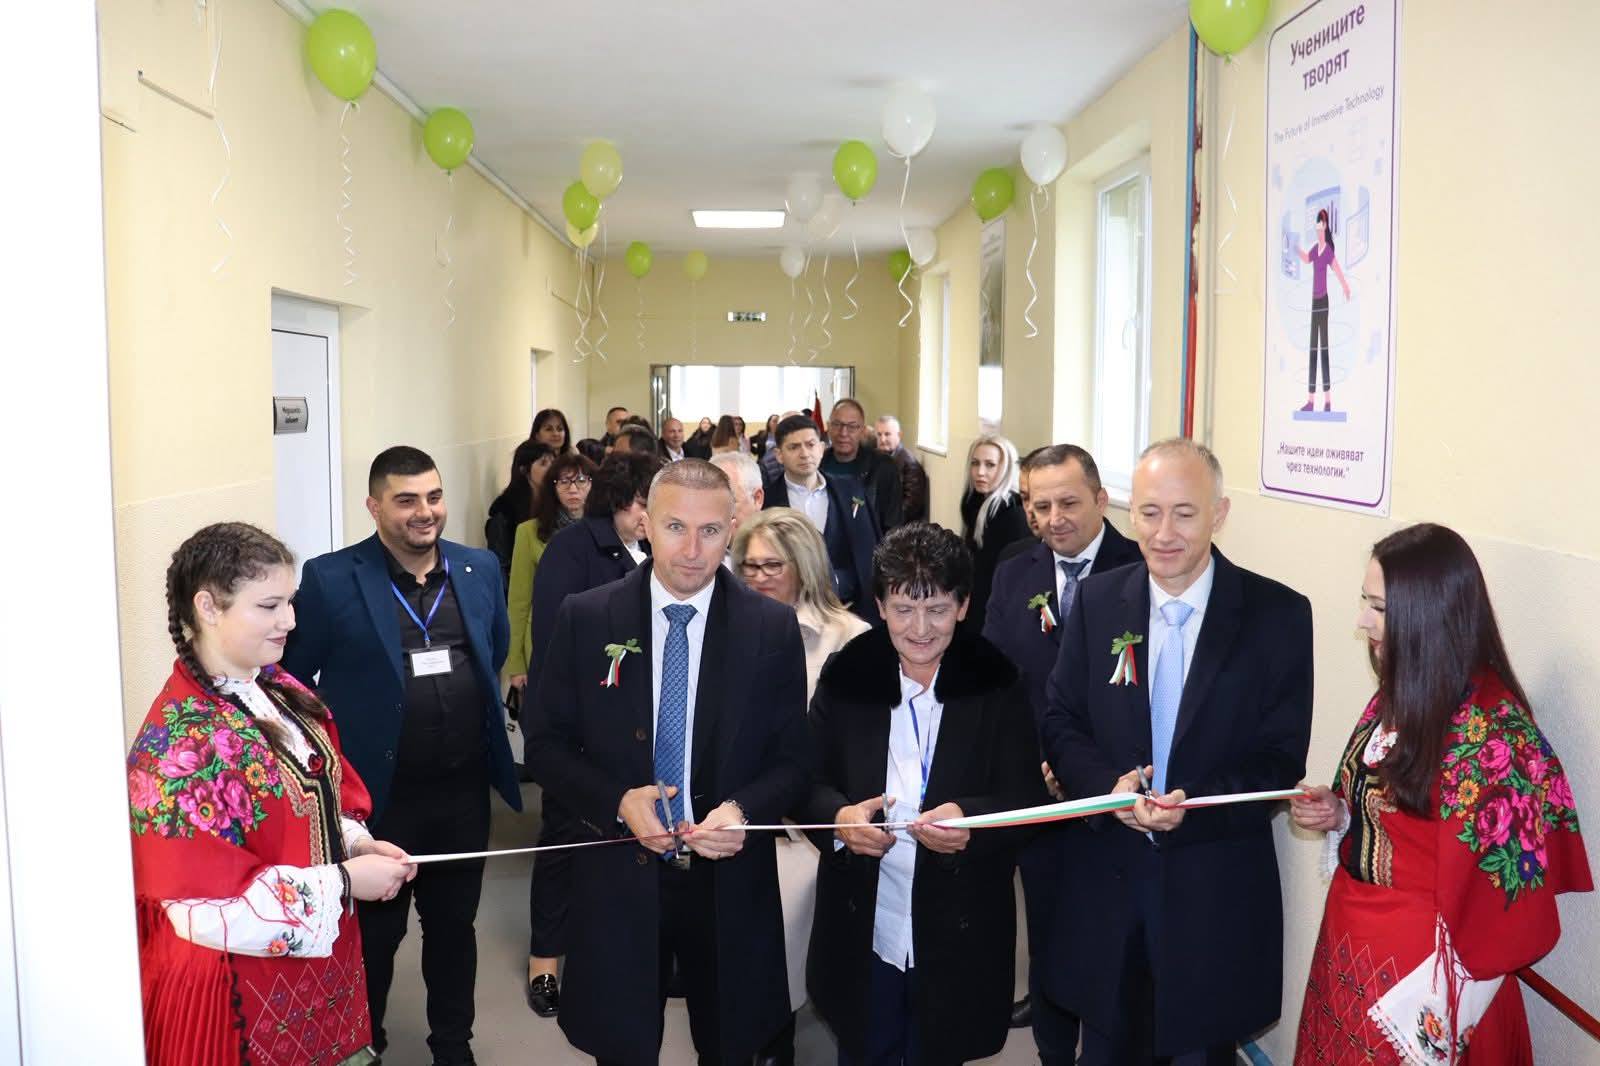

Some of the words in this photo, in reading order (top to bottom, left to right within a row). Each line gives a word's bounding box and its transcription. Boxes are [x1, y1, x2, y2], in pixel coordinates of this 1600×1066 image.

[1290, 4, 1365, 66] Учениците
[1303, 49, 1350, 90] творят
[1273, 132, 1284, 144] The
[1285, 124, 1302, 141] Future
[1304, 118, 1311, 131] of
[1311, 105, 1344, 127] Immersive
[1344, 85, 1384, 110] Technology
[1286, 461, 1302, 475] чрез
[1306, 446, 1325, 459] идеи
[1325, 448, 1364, 462] оживяват
